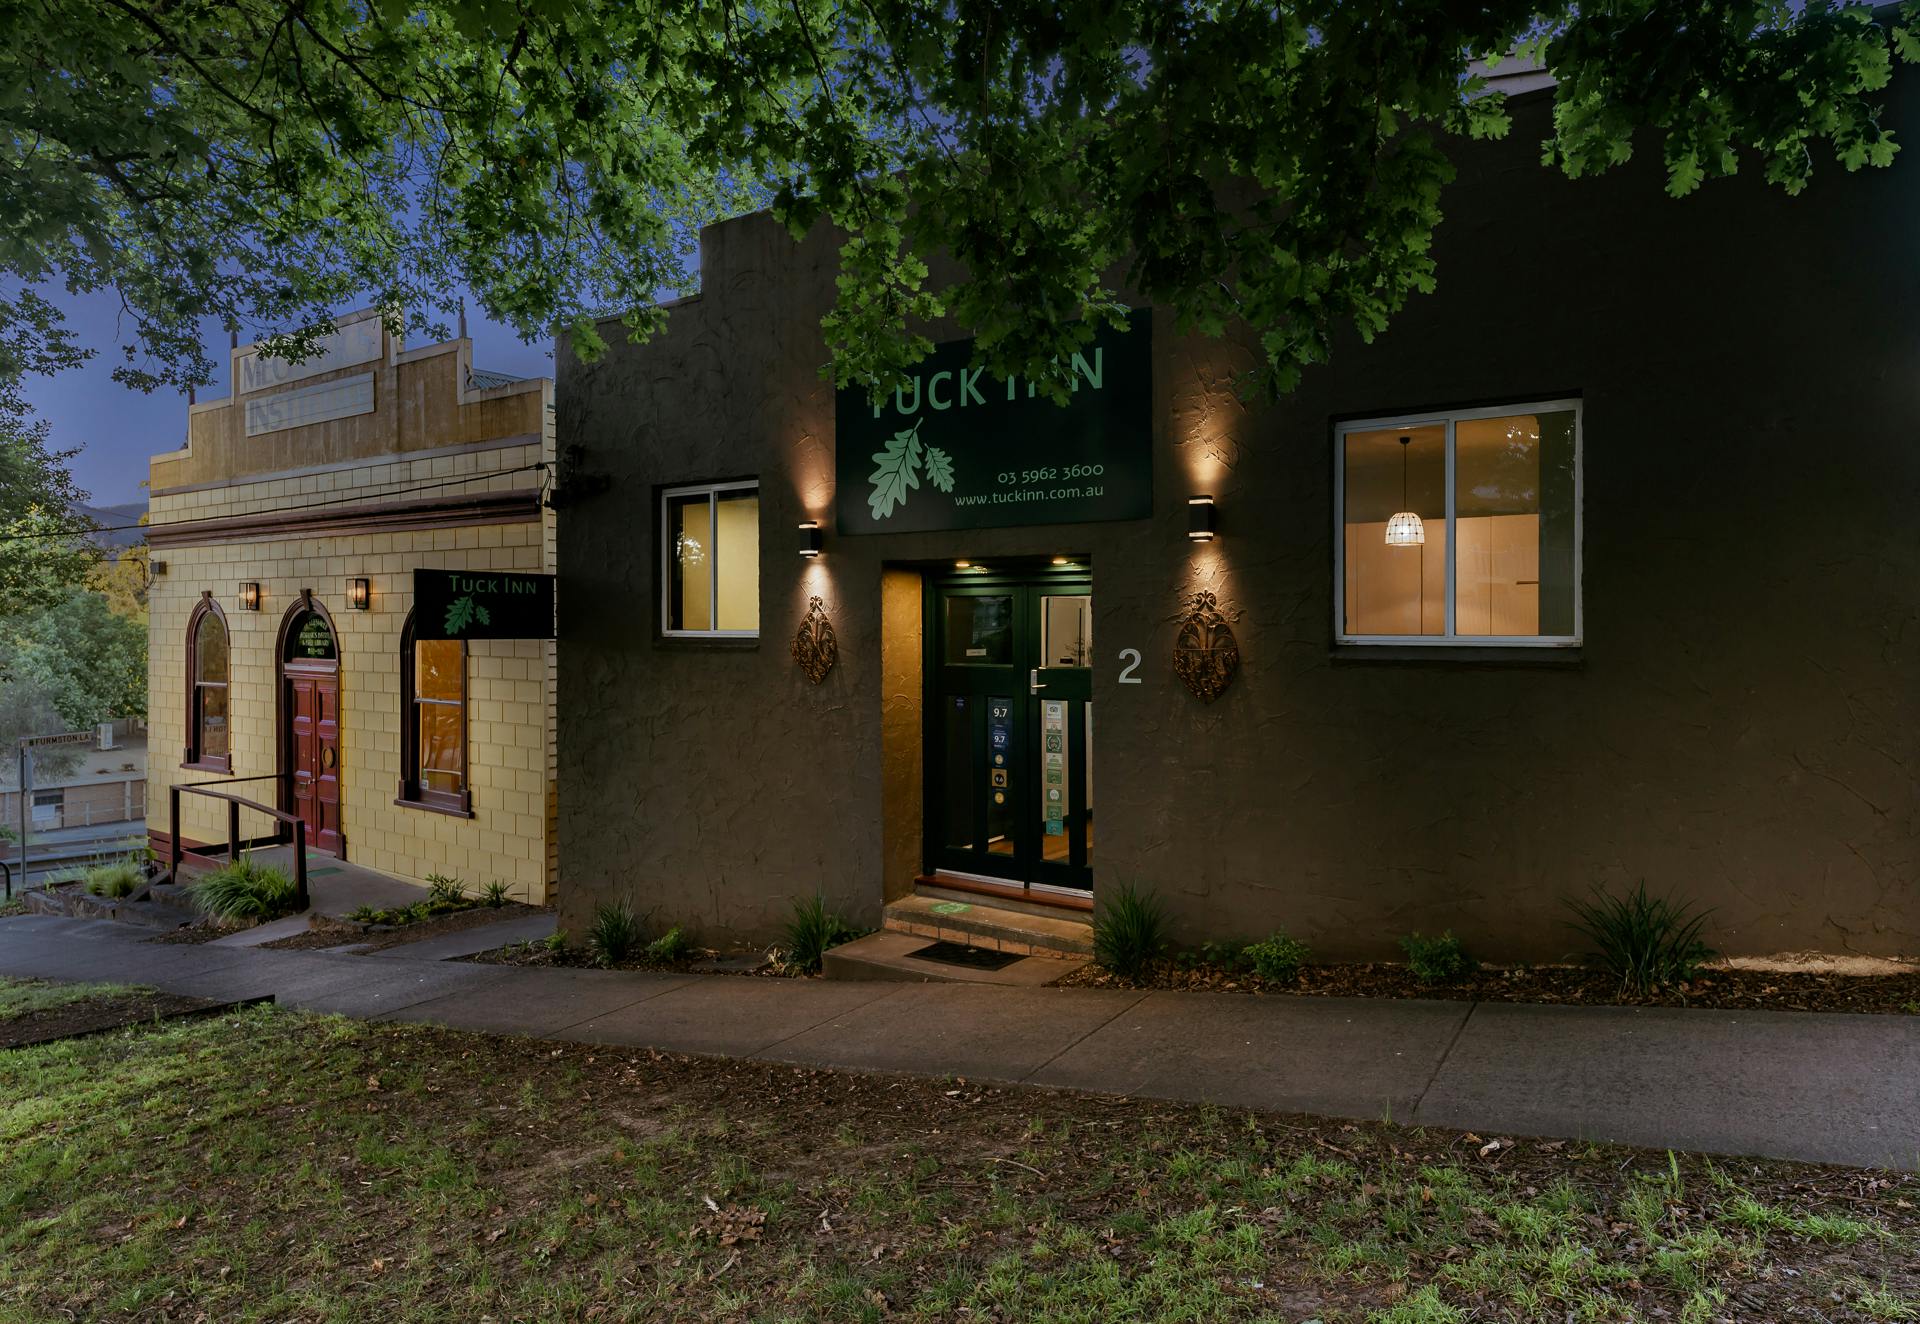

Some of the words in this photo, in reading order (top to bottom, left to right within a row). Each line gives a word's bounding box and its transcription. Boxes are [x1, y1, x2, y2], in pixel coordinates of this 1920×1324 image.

[997, 472, 1017, 485] 03
[1022, 467, 1057, 483] 5962
[1063, 464, 1104, 481] 3600
[955, 486, 1104, 506] www.tuckinn.com.au
[1118, 648, 1142, 684] 2
[993, 707, 1008, 718] 9.7
[36, 734, 78, 746] FURMSTON
[994, 735, 1006, 743] 9.7
